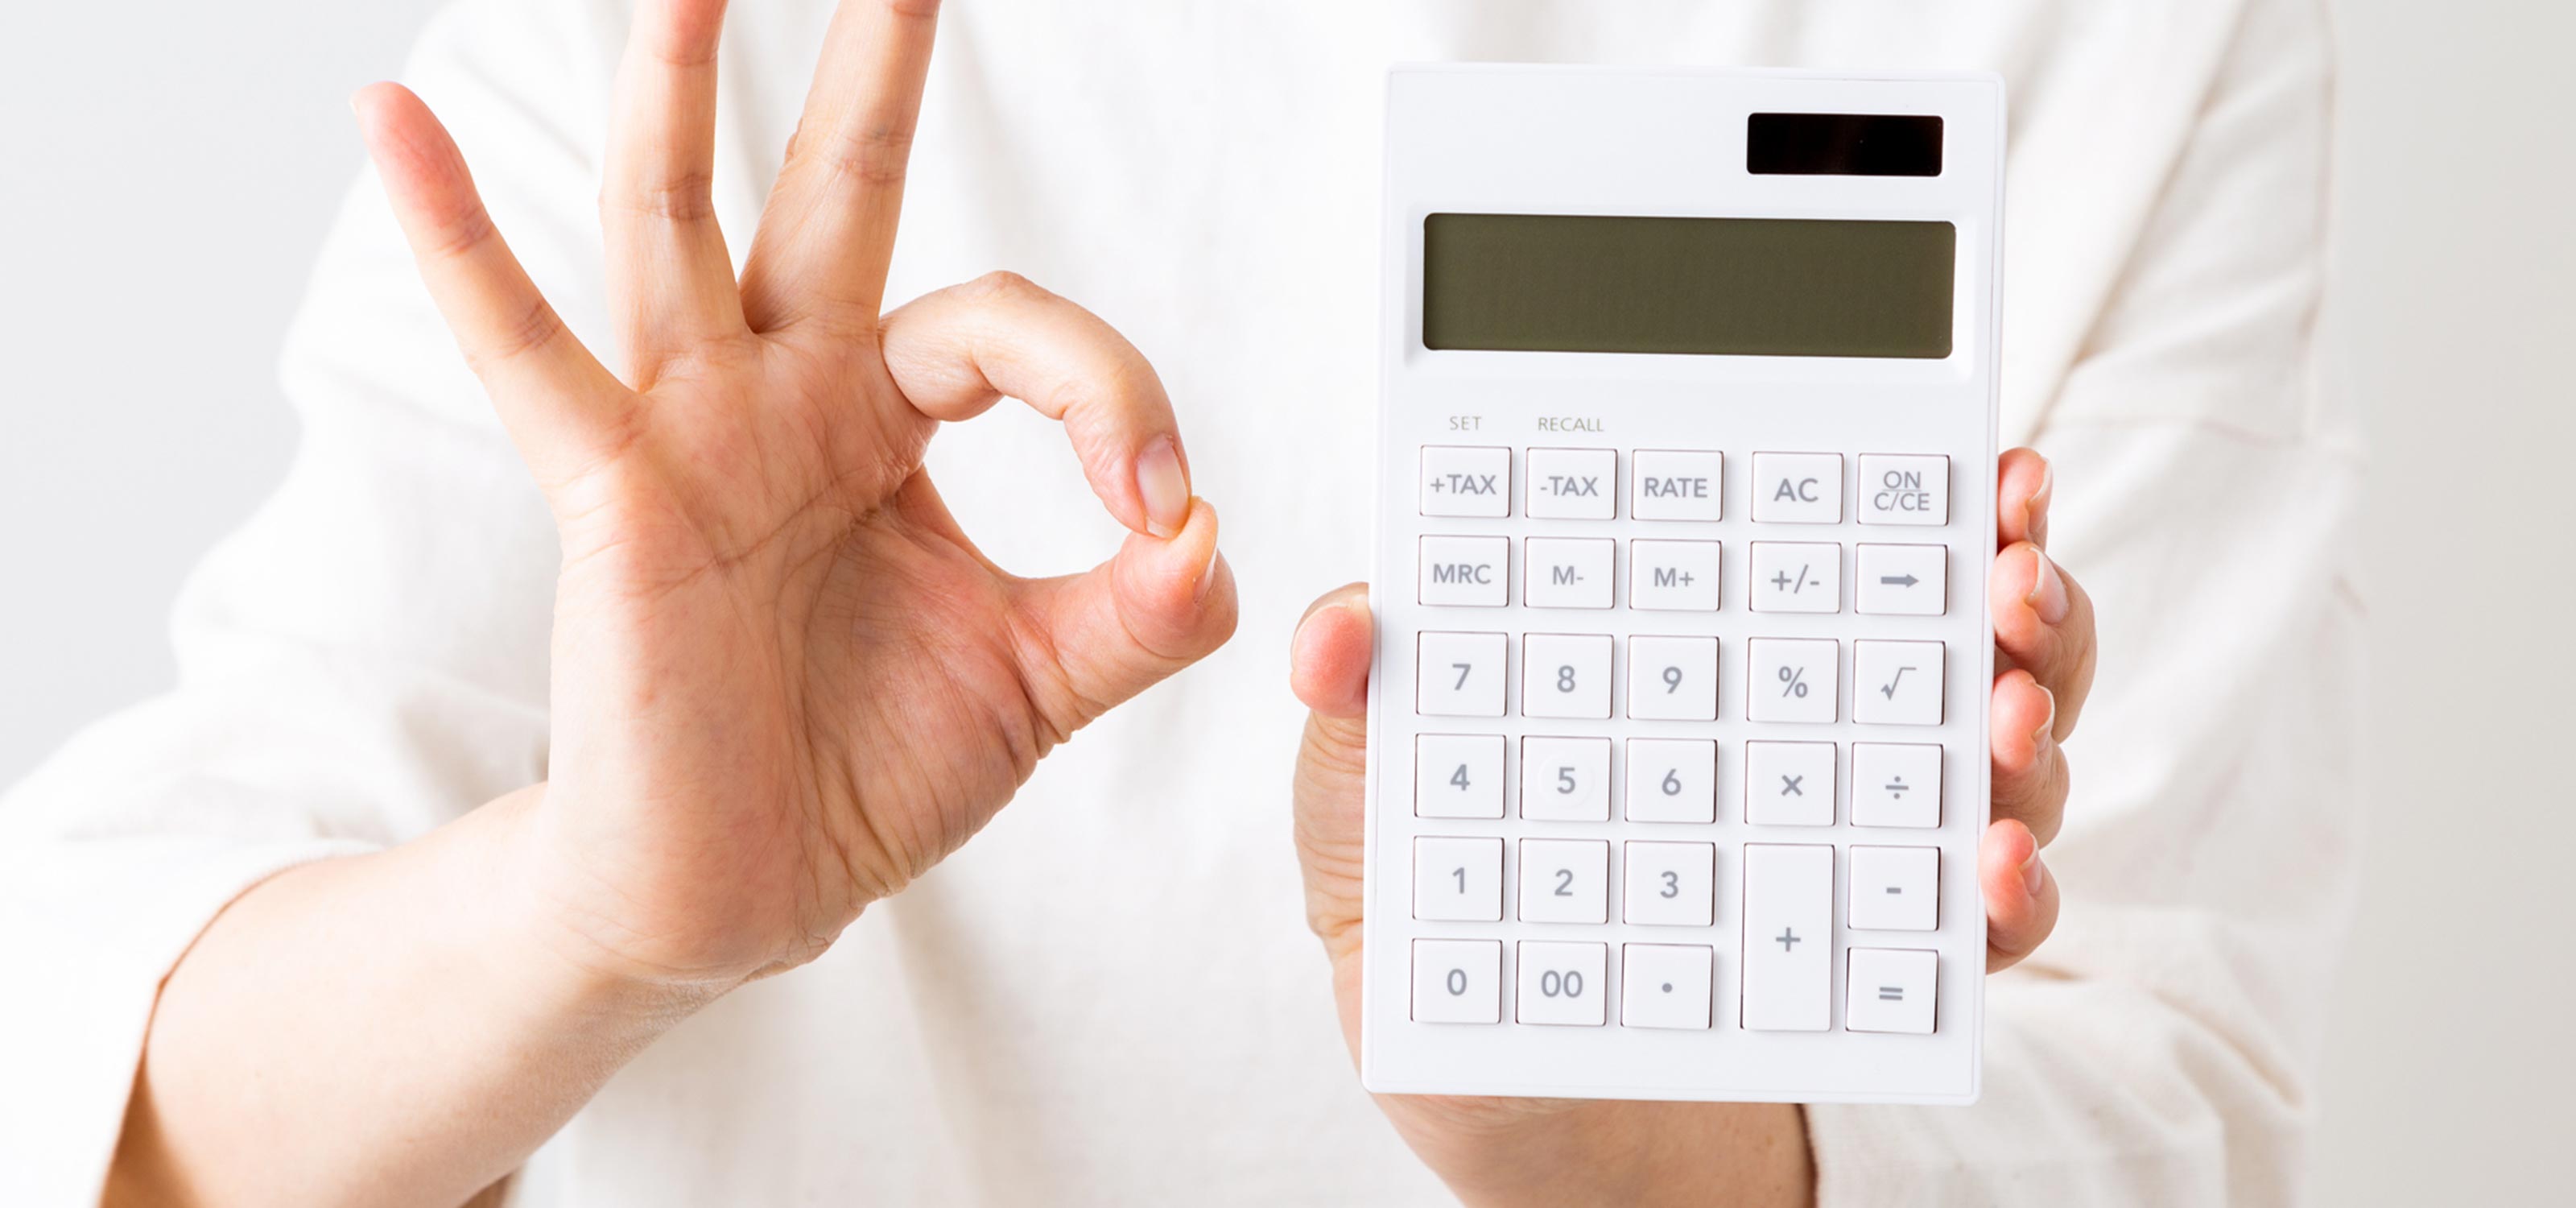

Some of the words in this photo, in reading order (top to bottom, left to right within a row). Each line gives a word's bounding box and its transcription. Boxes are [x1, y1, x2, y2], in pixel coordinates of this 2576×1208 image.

[1449, 416, 1482, 431] SET
[1538, 416, 1604, 432] RECALL
[1430, 474, 1497, 495] +TAX
[1540, 475, 1599, 497] -TAX
[1644, 476, 1708, 499] RATE
[1773, 477, 1819, 503] AC
[1883, 470, 1922, 486] ON
[1873, 491, 1930, 511] C/CE
[1433, 563, 1492, 585] MRC
[1552, 565, 1584, 586] M-
[1653, 566, 1695, 588] M+
[1451, 663, 1472, 691] 7
[1556, 664, 1576, 693] 8
[1662, 665, 1683, 694] 9
[1777, 665, 1809, 699] %
[1449, 763, 1472, 792] 4
[1556, 766, 1576, 795] 5
[1661, 767, 1682, 796] 6
[1451, 867, 1465, 895] 1
[1554, 868, 1574, 897] 2
[1659, 870, 1679, 900] 3
[1775, 926, 1802, 953] +
[1446, 968, 1468, 997] 0
[1540, 969, 1583, 999] 00
